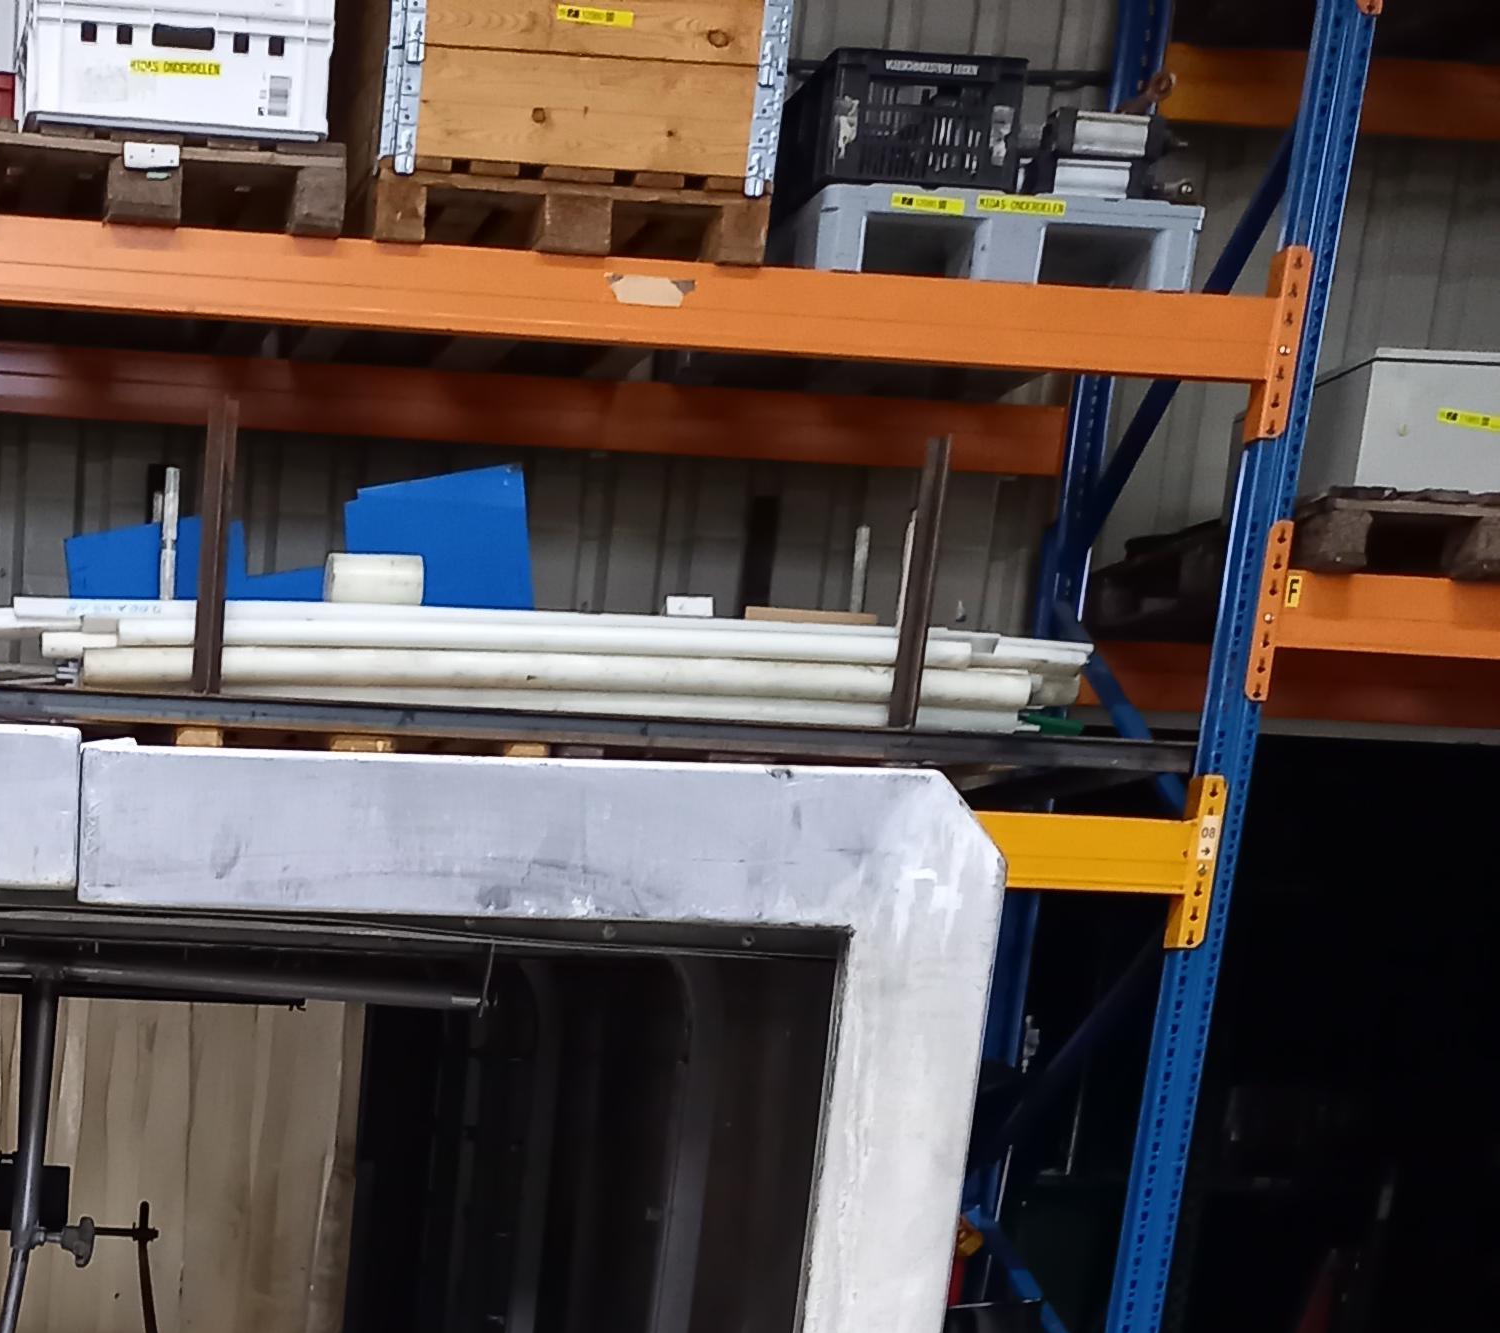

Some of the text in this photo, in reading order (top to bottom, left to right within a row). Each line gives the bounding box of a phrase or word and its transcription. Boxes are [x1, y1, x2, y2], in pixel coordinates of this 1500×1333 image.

[979, 197, 1064, 214] MIDAS ONDERDELEN
[1287, 579, 1300, 603] F
[1201, 827, 1216, 839] 08
